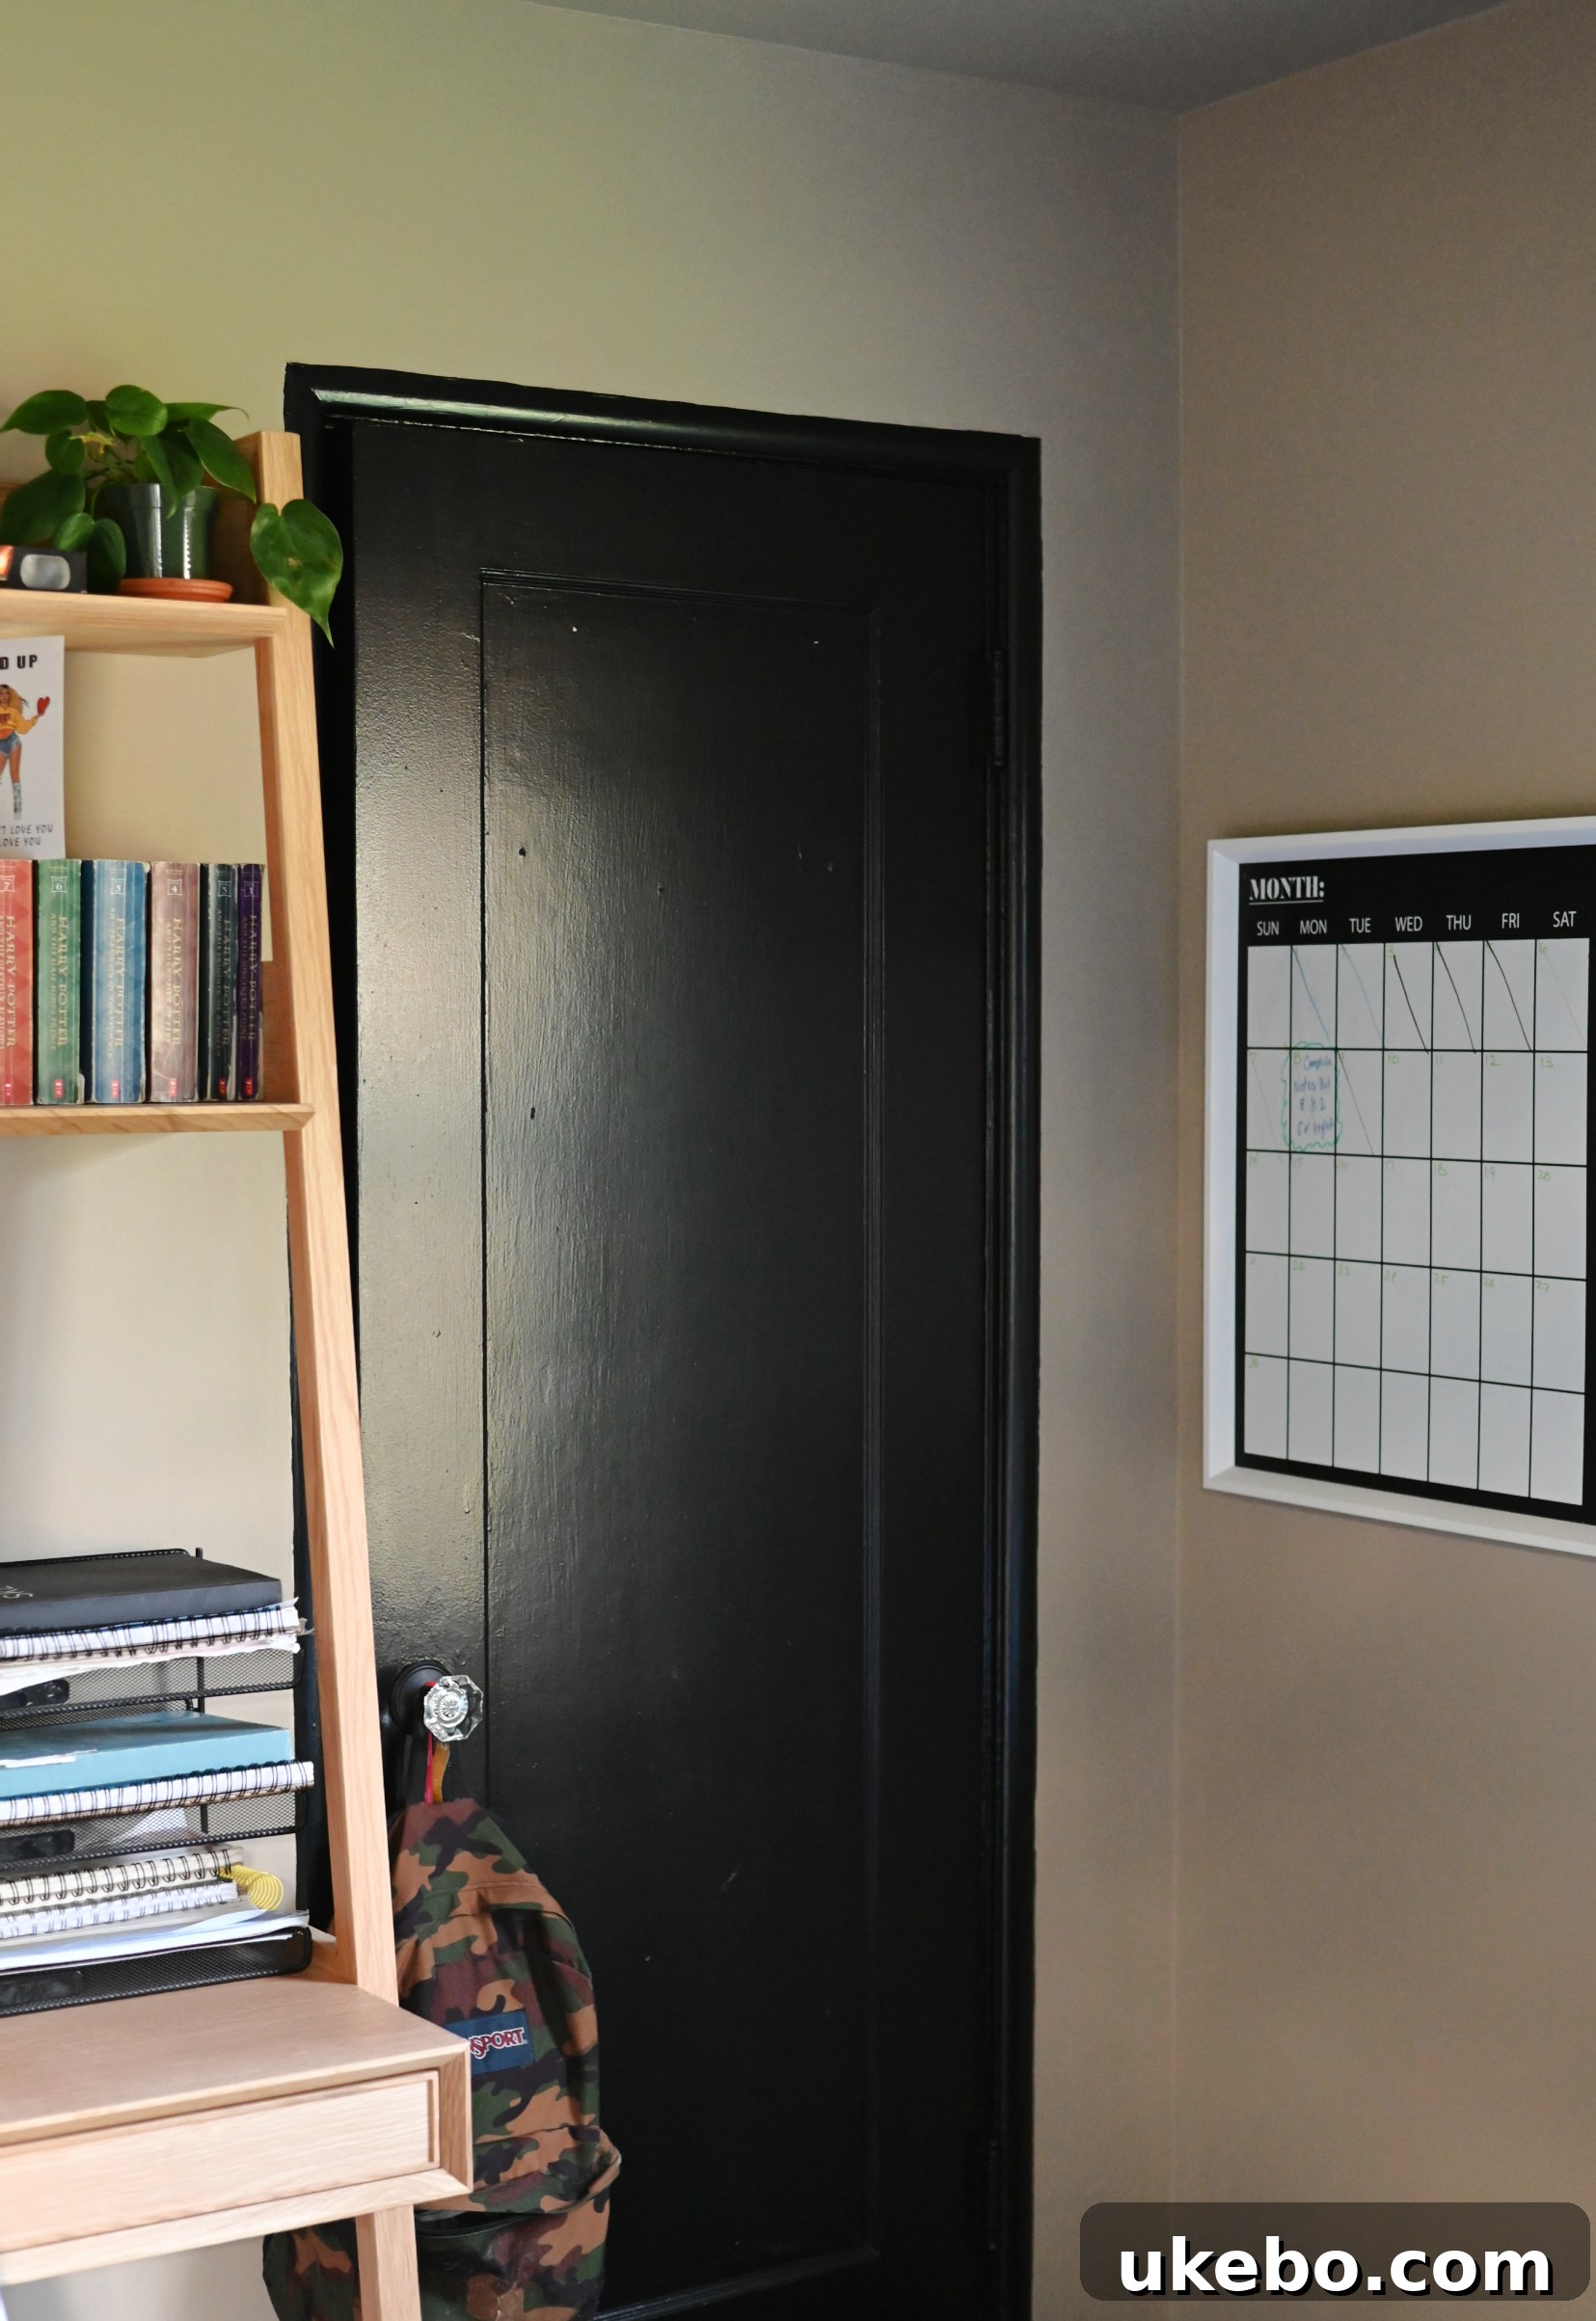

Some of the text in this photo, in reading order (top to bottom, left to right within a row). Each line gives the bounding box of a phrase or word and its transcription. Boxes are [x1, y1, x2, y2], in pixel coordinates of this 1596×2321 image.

[16, 654, 38, 669] UP
[11, 824, 32, 835] LOVE
[36, 823, 53, 834] YOU
[24, 836, 41, 847] YOU
[1249, 876, 1325, 901] MONTH:
[1257, 910, 1577, 936] SUN MON TUE WED THU FRI SAT
[7, 915, 16, 1047] HARRY POTTER
[57, 915, 68, 1047] HARRY POTTER
[115, 917, 125, 1047] HARRY POTTER
[172, 917, 182, 1048] HARRY POTTER
[222, 919, 232, 1045] HARRY POTTER
[247, 914, 258, 1041] HARRY POTTER
[1388, 1054, 1399, 1065] 10
[1435, 1054, 1443, 1066] 11
[1485, 1054, 1501, 1066] 12
[1540, 1056, 1555, 1068] 13
[1434, 1162, 1448, 1177] 18
[1434, 1273, 1449, 1286] 25
[1535, 1280, 1551, 1293] 27
[469, 2027, 525, 2059] SPORT
